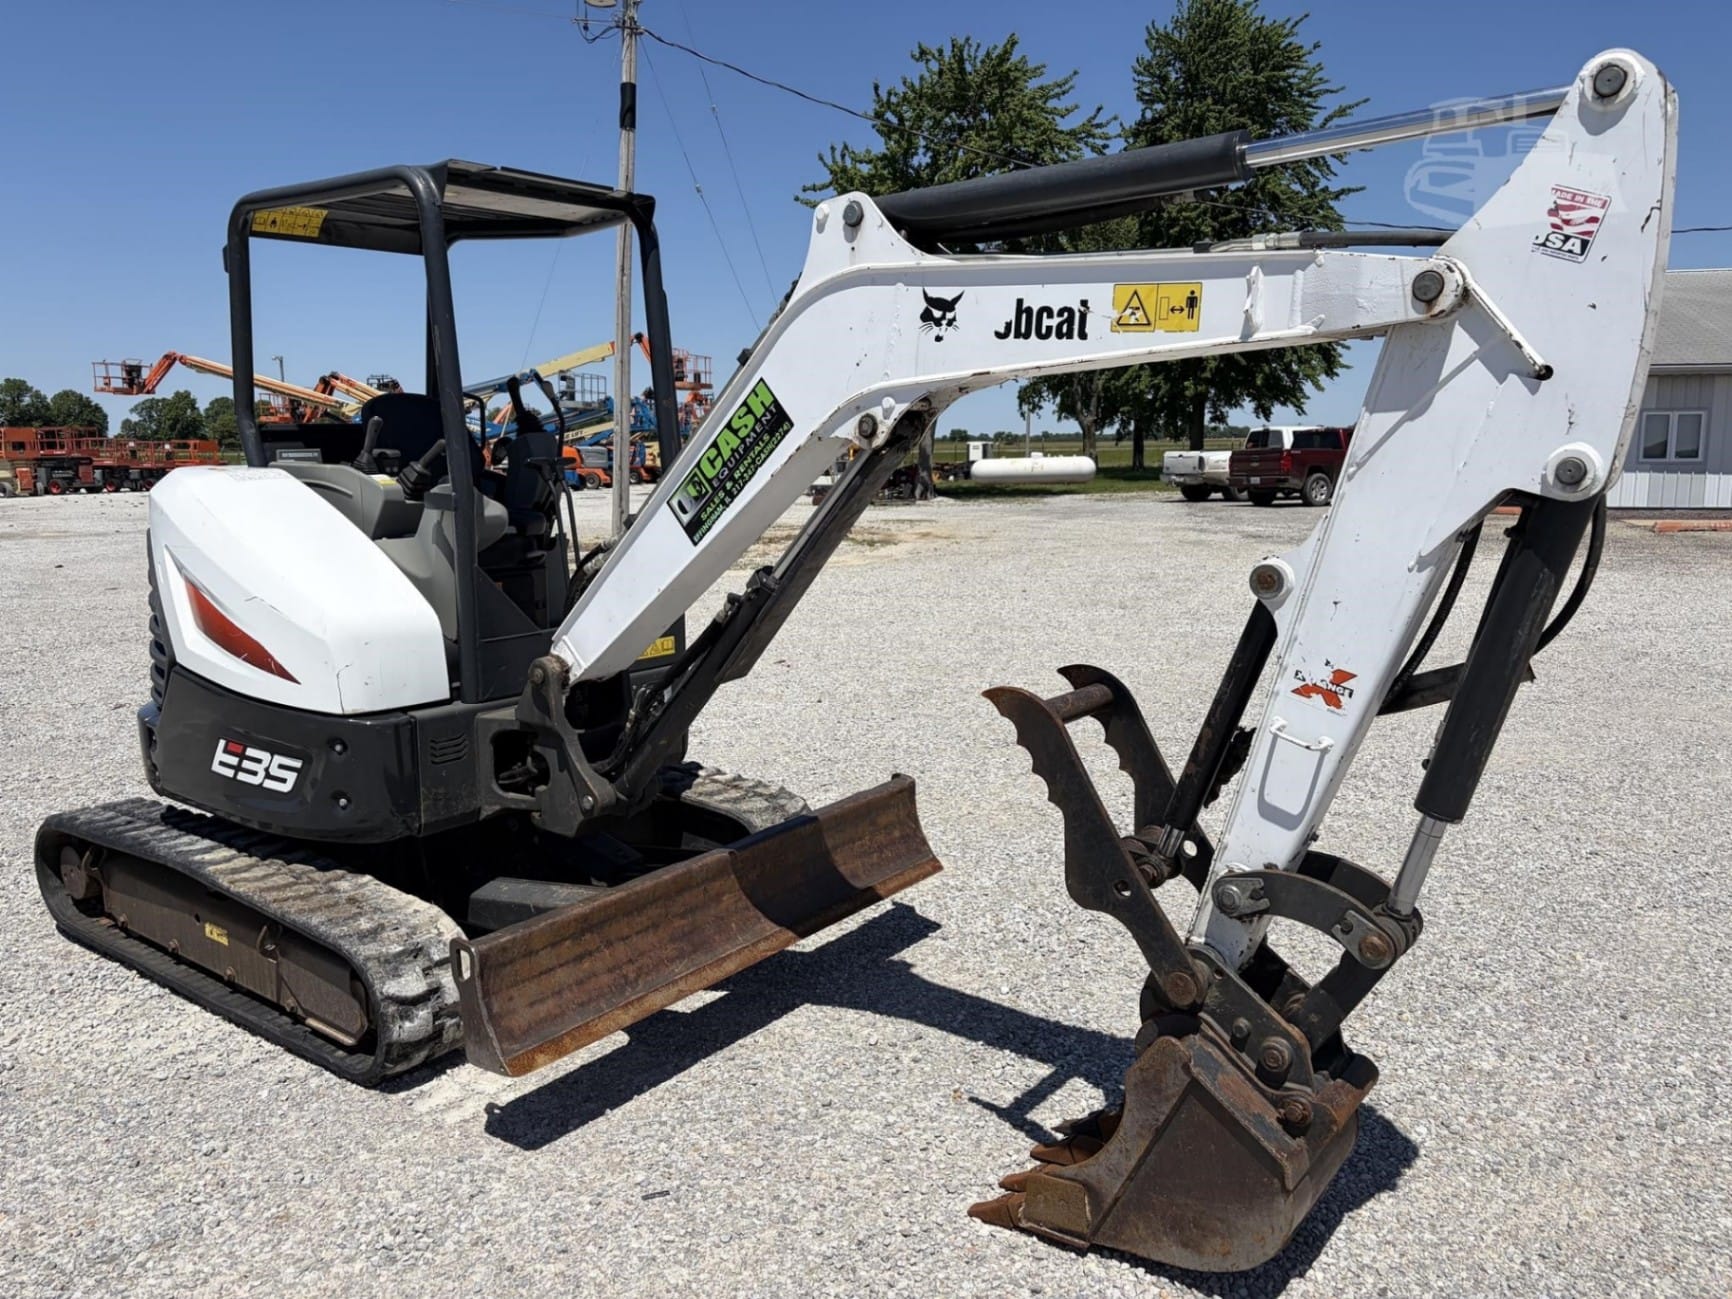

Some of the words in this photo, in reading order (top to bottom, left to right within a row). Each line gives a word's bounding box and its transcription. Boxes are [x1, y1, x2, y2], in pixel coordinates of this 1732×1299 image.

[697, 378, 775, 482] CASH
[710, 402, 778, 489] EQUIPMENT
[699, 488, 725, 522] SALES
[724, 477, 734, 491] &
[732, 431, 771, 480] RENTALS
[210, 738, 303, 793] E35
